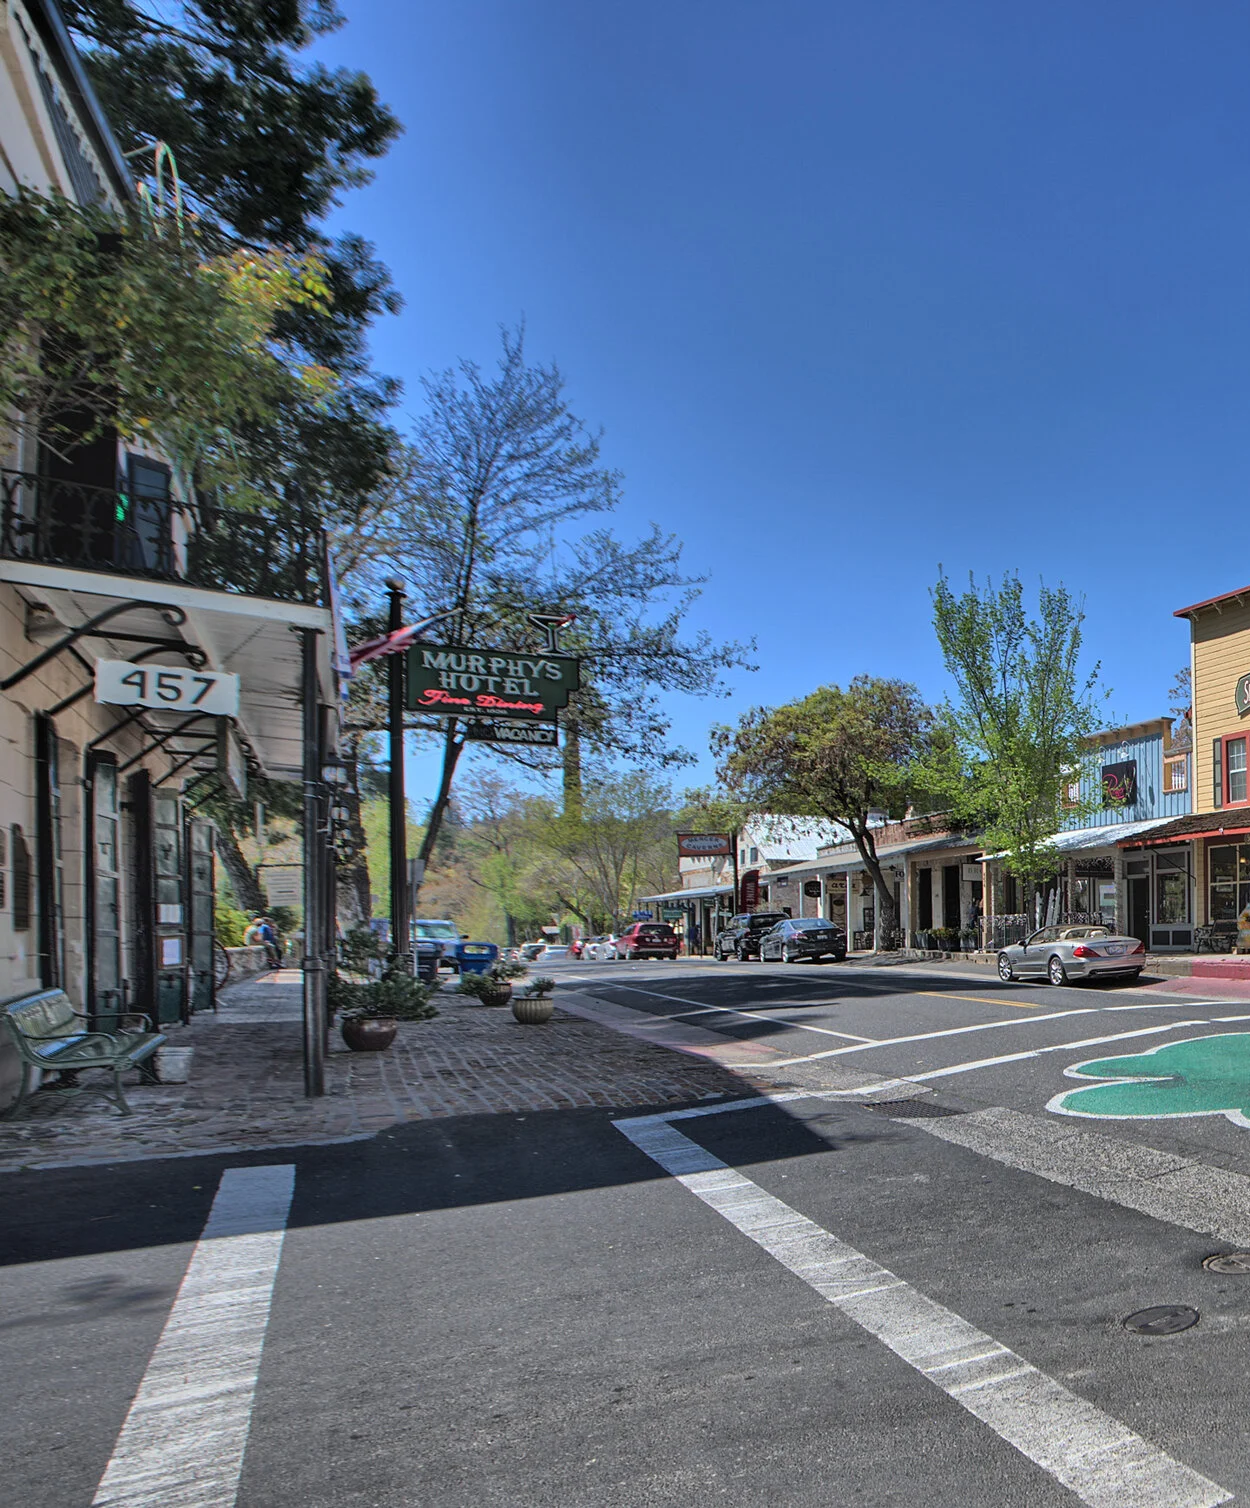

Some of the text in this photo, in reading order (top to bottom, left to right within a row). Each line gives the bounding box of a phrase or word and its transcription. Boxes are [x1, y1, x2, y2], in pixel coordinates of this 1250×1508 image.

[421, 650, 563, 681] MURPHYS
[121, 670, 217, 704] 457
[438, 672, 540, 697] HOTEL
[494, 726, 554, 742] VACANCY
